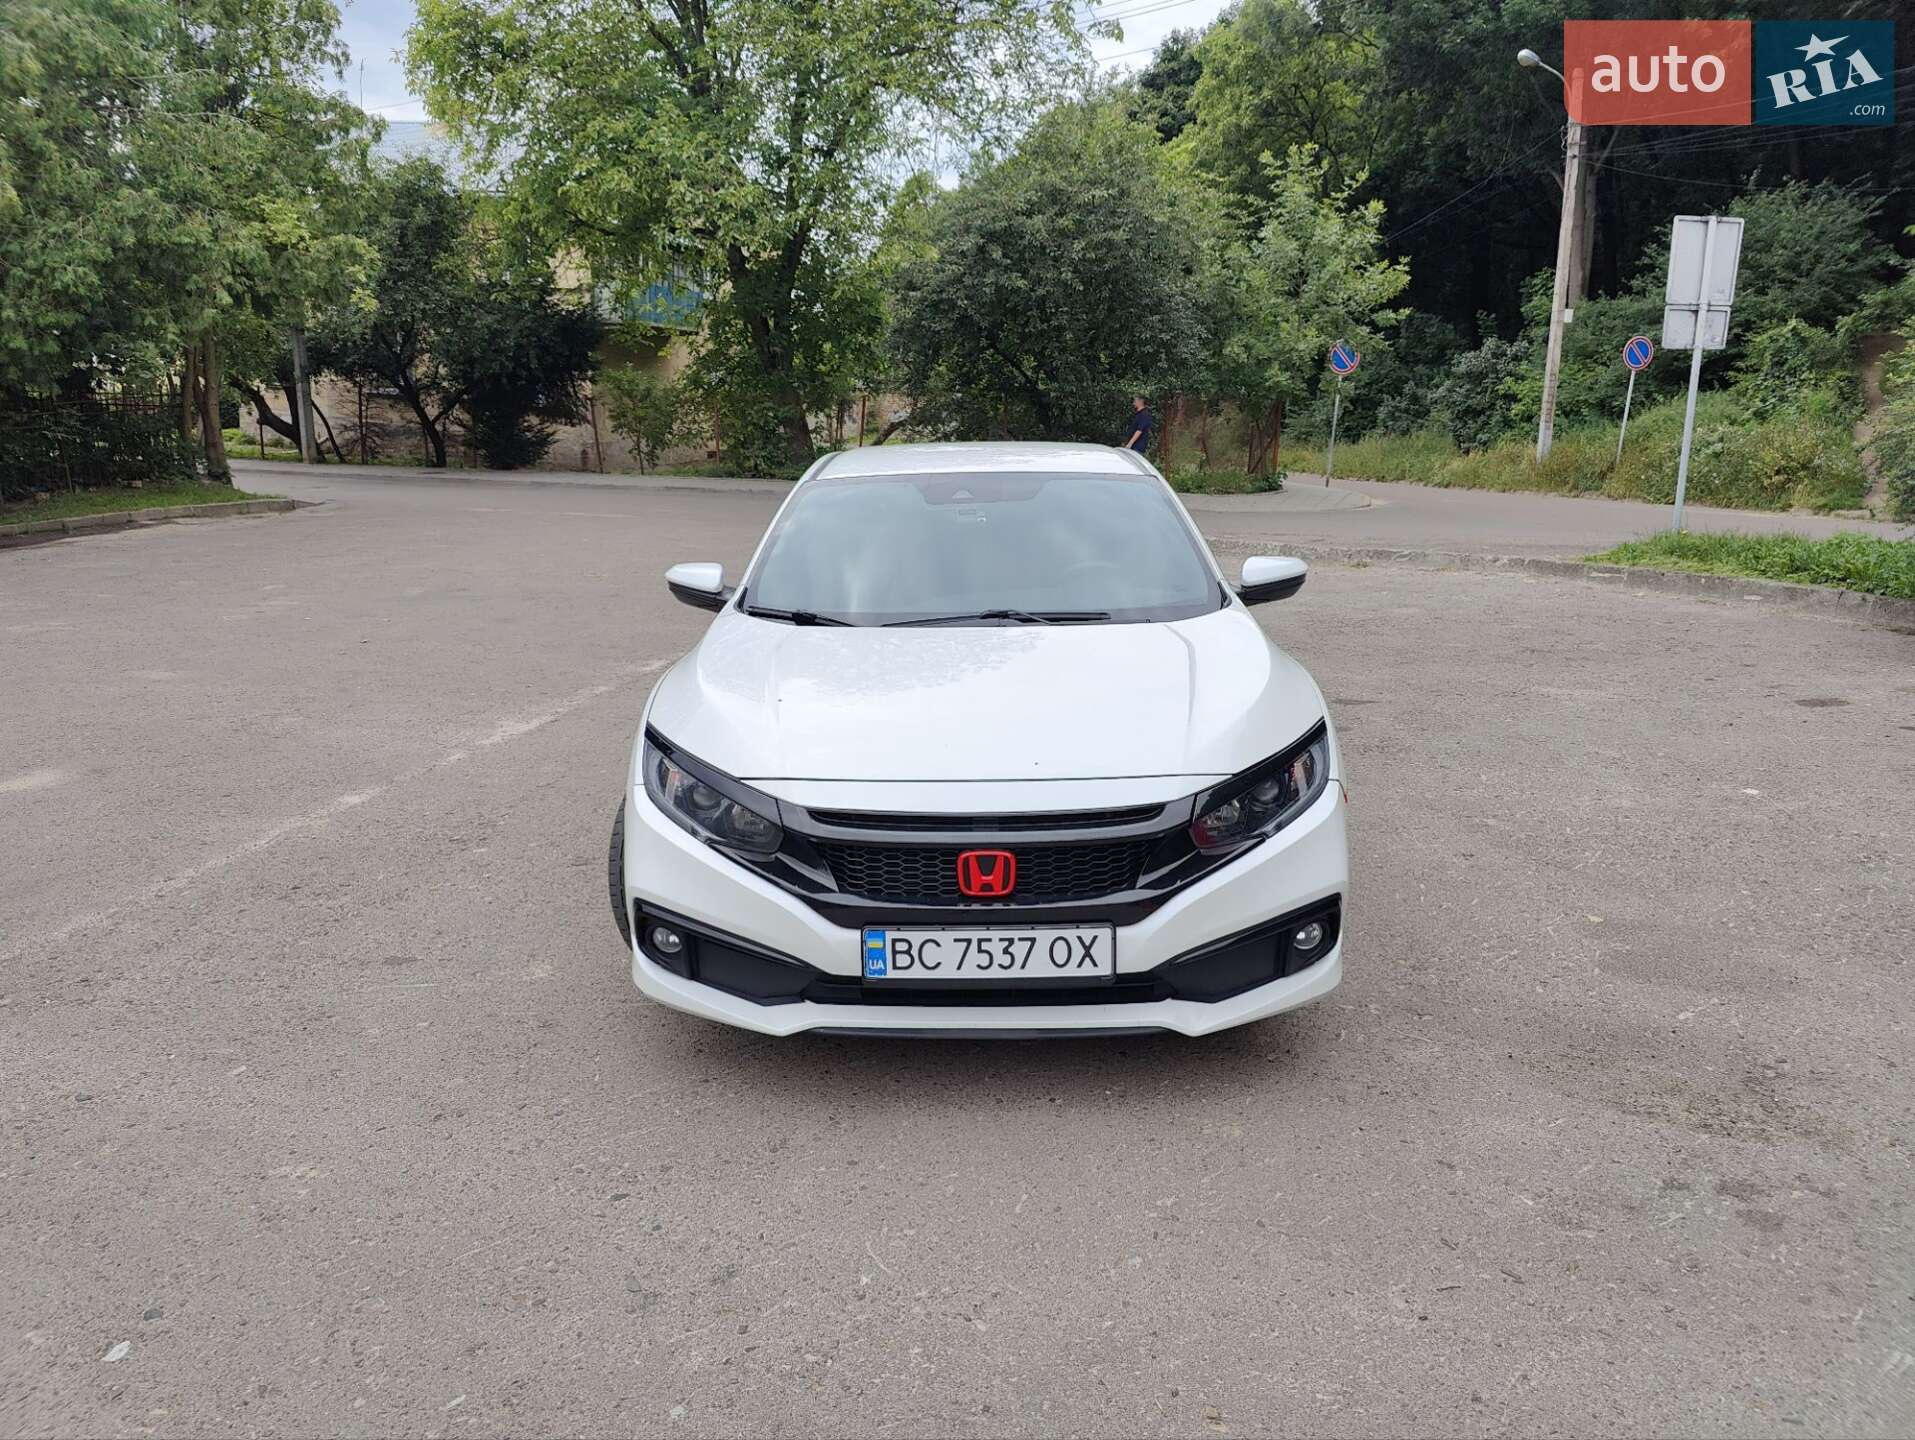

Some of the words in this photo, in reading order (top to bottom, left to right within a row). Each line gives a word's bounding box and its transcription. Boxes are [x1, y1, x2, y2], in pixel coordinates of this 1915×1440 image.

[869, 959, 885, 970] UA
[891, 937, 942, 971] BC
[953, 936, 1037, 970] 7537
[1049, 934, 1099, 969] OX
